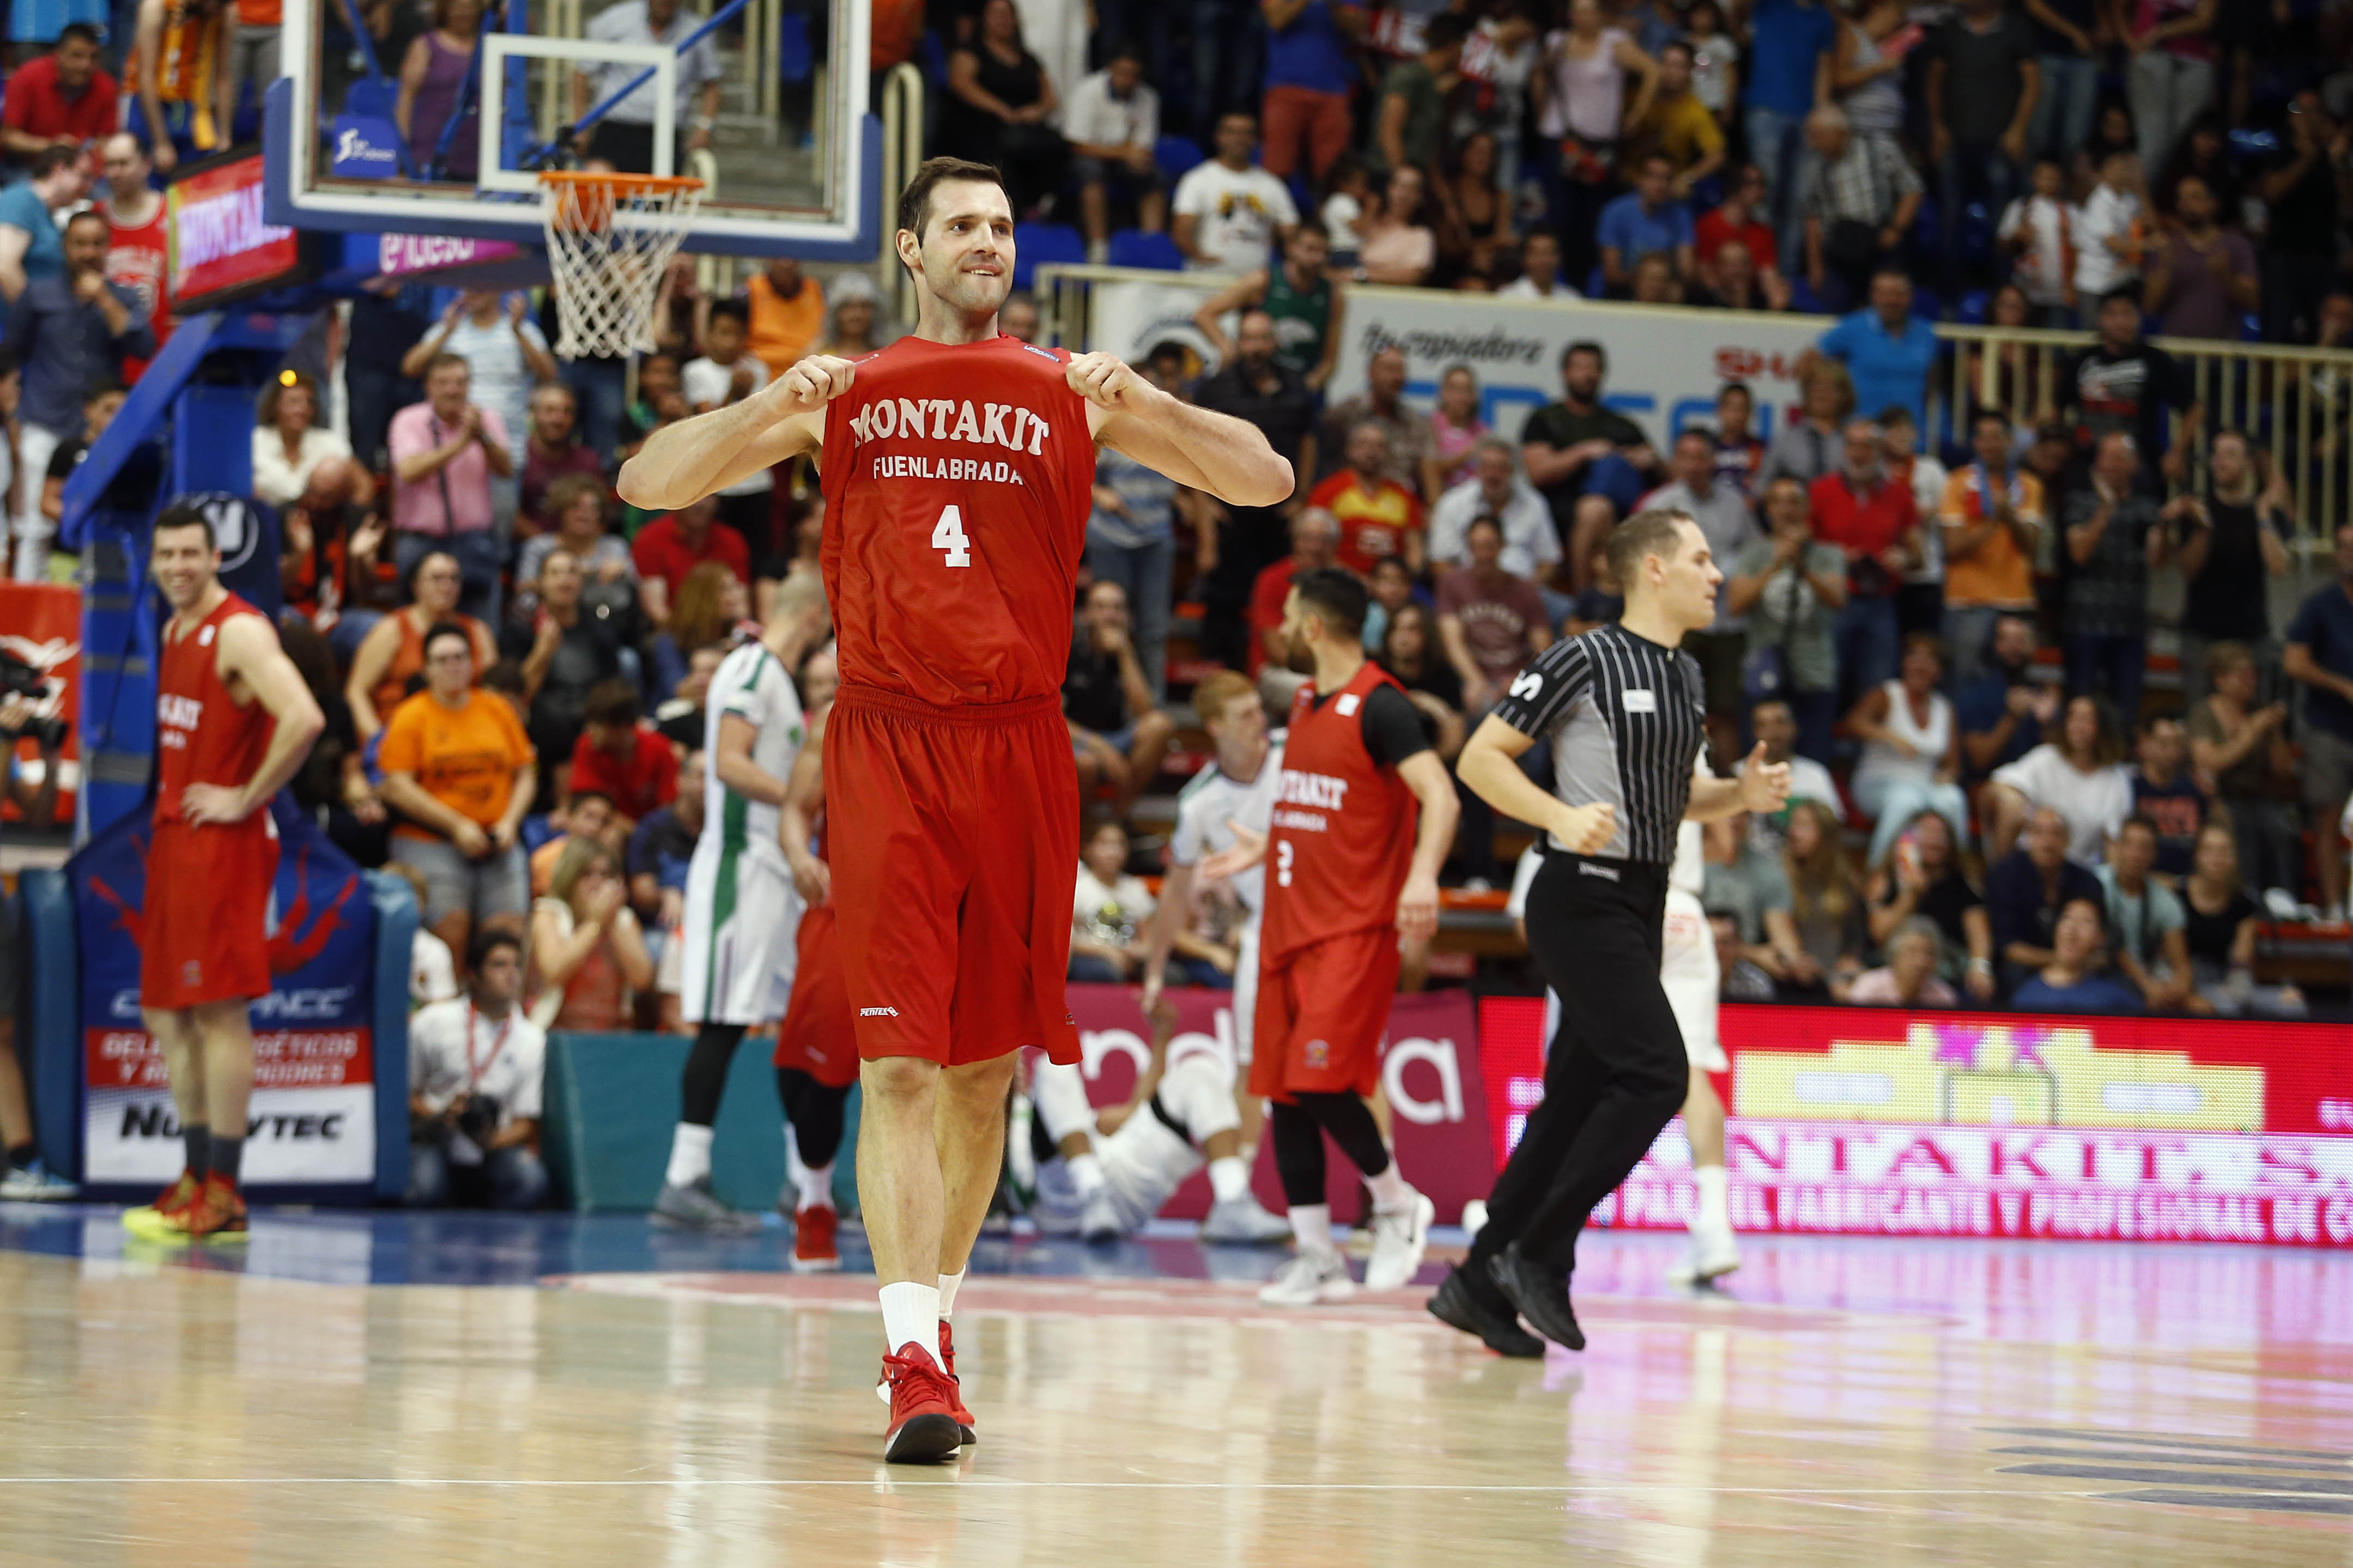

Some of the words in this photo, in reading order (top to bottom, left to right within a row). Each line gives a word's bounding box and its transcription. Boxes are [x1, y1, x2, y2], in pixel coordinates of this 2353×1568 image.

[849, 398, 1050, 455] MONTAKIT
[873, 456, 1023, 485] FUENLABRADA
[931, 505, 971, 567] 4
[860, 1007, 889, 1017] PENTEX
